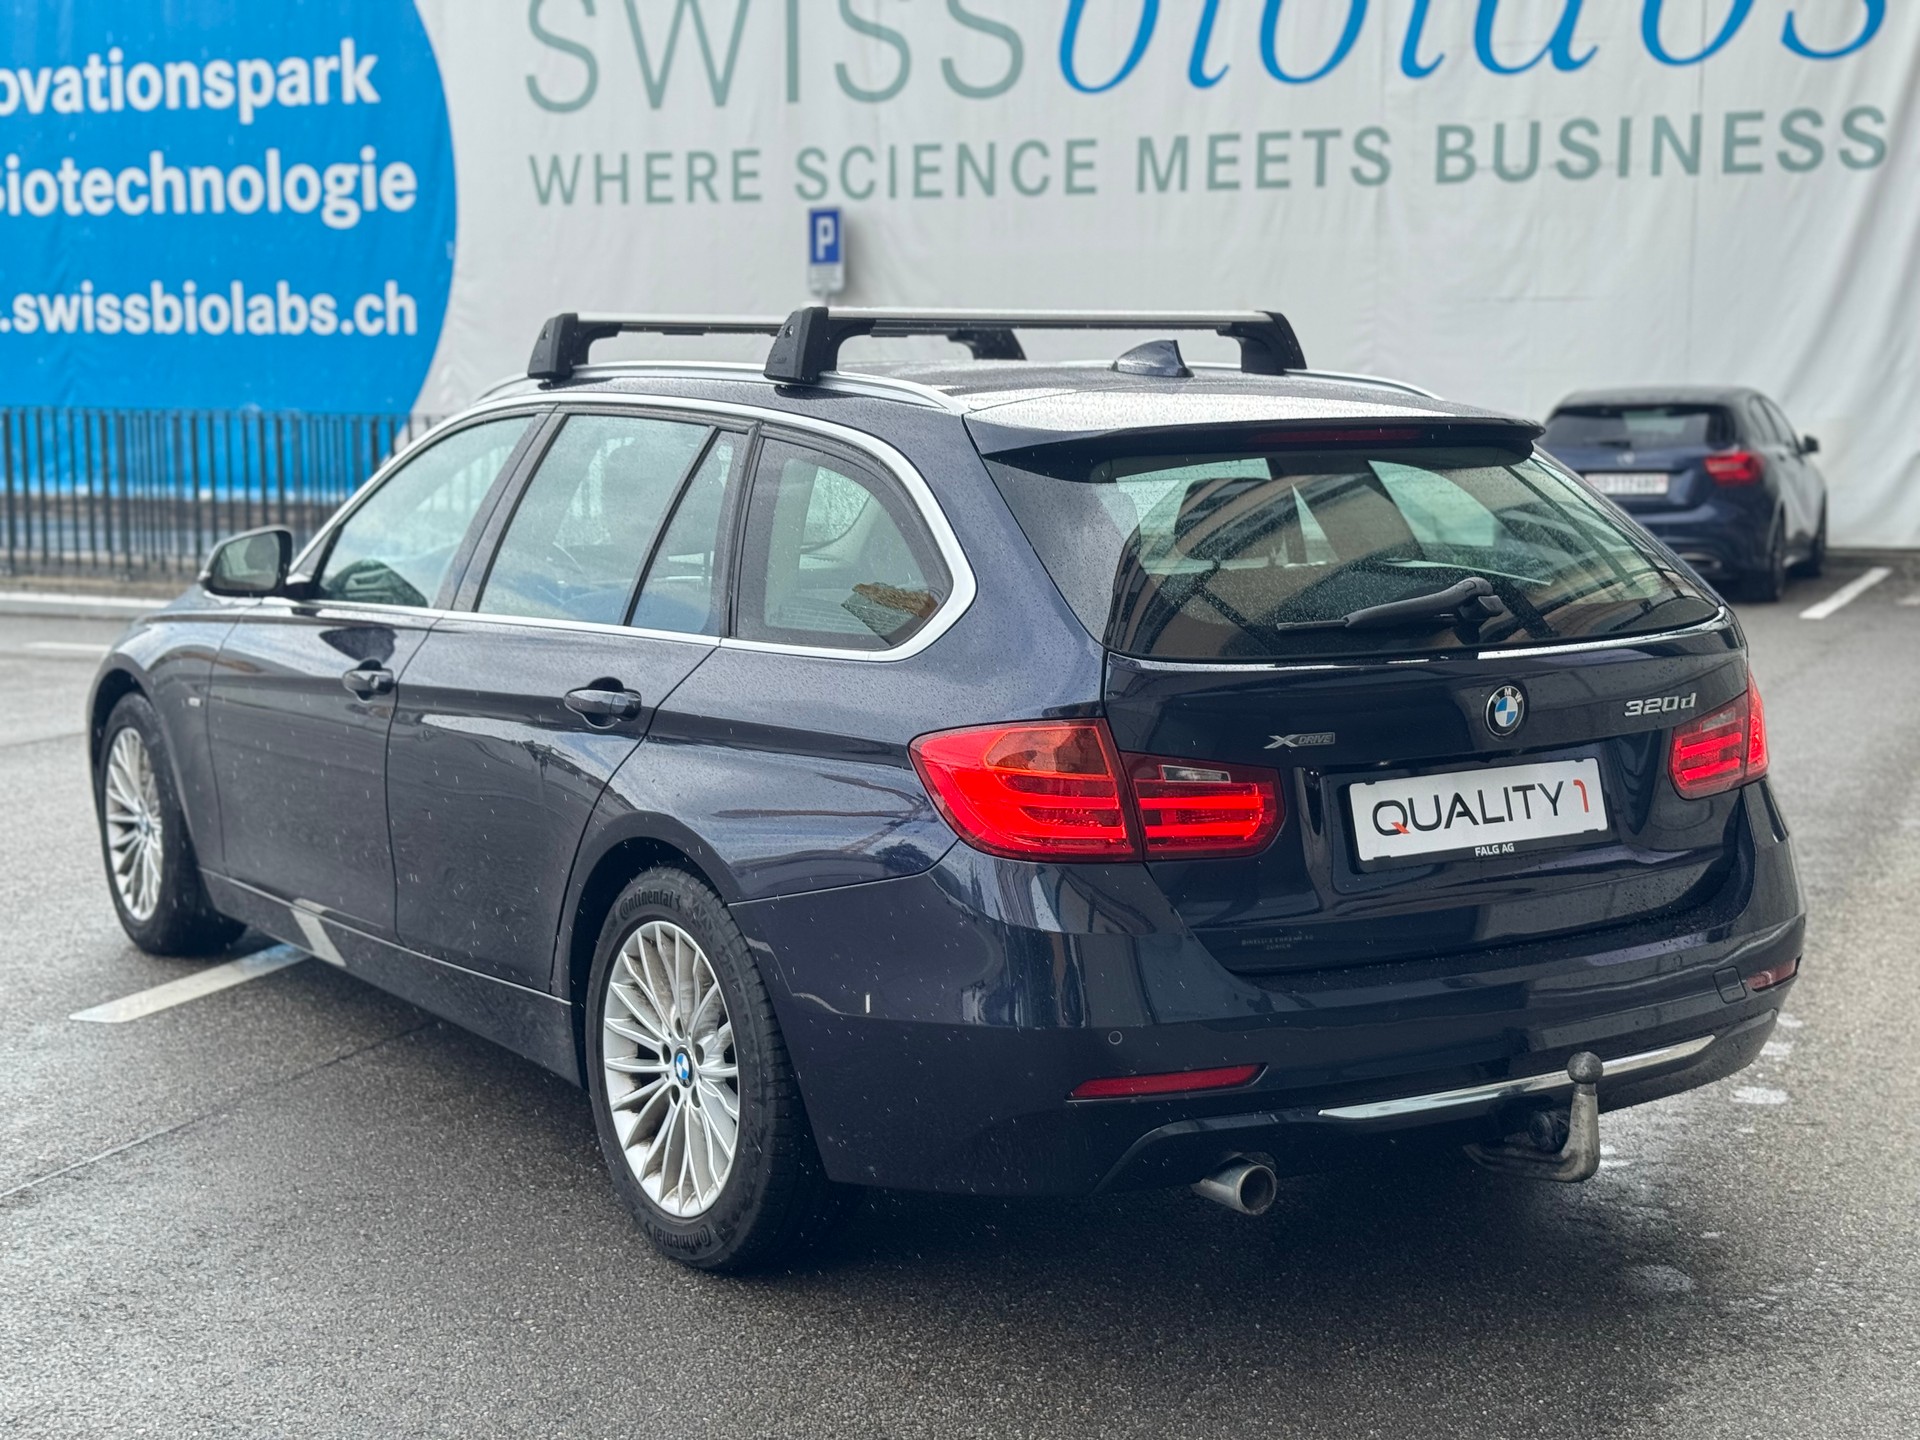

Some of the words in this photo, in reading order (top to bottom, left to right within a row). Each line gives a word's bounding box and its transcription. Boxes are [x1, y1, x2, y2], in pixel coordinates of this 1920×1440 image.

[529, 149, 762, 205] WHERE
[794, 138, 1097, 201] SCIENCE
[1136, 126, 1392, 193] MEETS
[1434, 105, 1888, 185] BUSINESS
[0, 146, 417, 229] iotechnologie
[816, 216, 835, 260] P
[1492, 687, 1522, 704] BMW
[1624, 693, 1696, 717] 320d
[1372, 781, 1564, 836] QUALITY
[1475, 845, 1500, 857] FALG
[1502, 843, 1515, 853] AG
[620, 889, 674, 920] Continental
